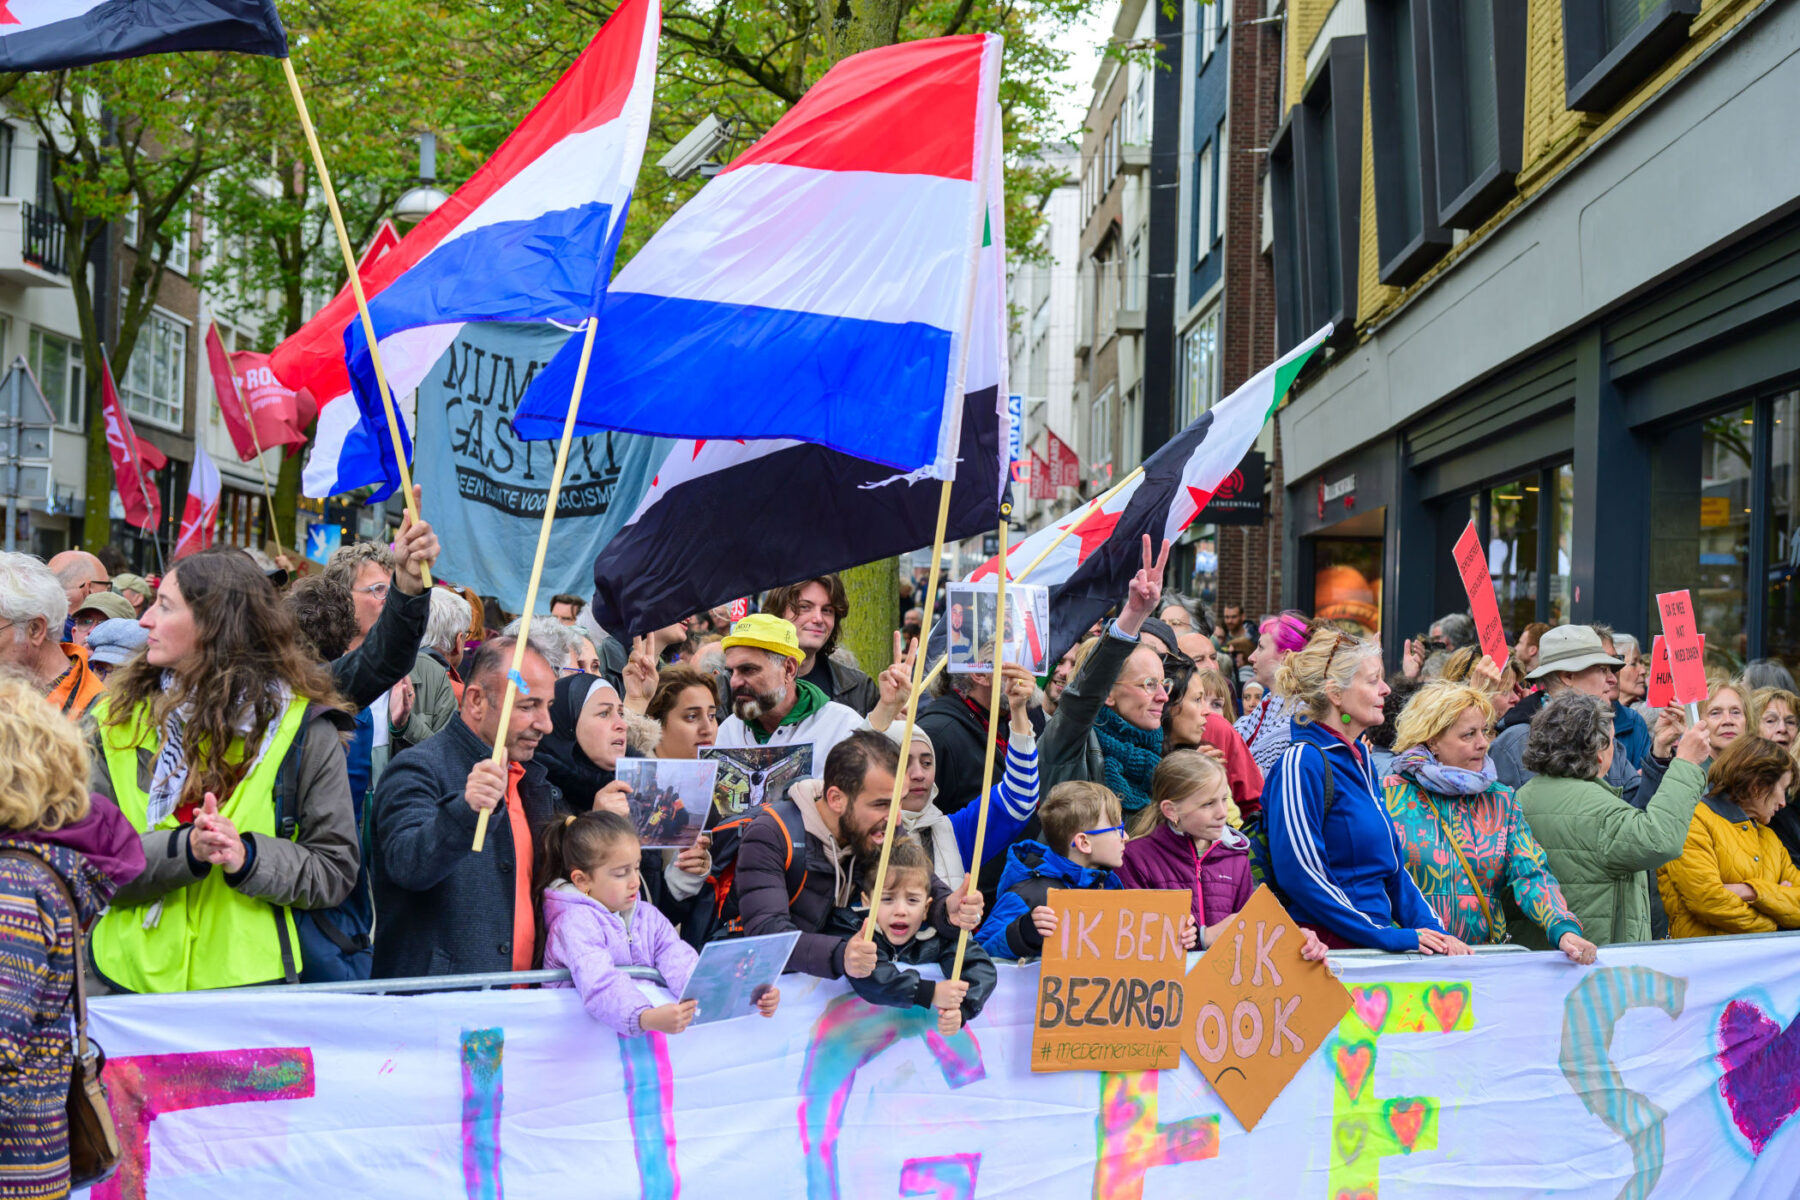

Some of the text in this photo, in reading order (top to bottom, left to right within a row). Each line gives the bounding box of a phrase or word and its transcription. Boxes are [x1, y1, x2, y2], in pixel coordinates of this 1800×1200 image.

[443, 341, 549, 415] NIJM
[457, 472, 486, 497] EEN
[520, 493, 548, 511] VOO
[1060, 908, 1187, 962] IK BEN
[1039, 975, 1184, 1031] BEZORGD
[1195, 995, 1305, 1063] OOK
